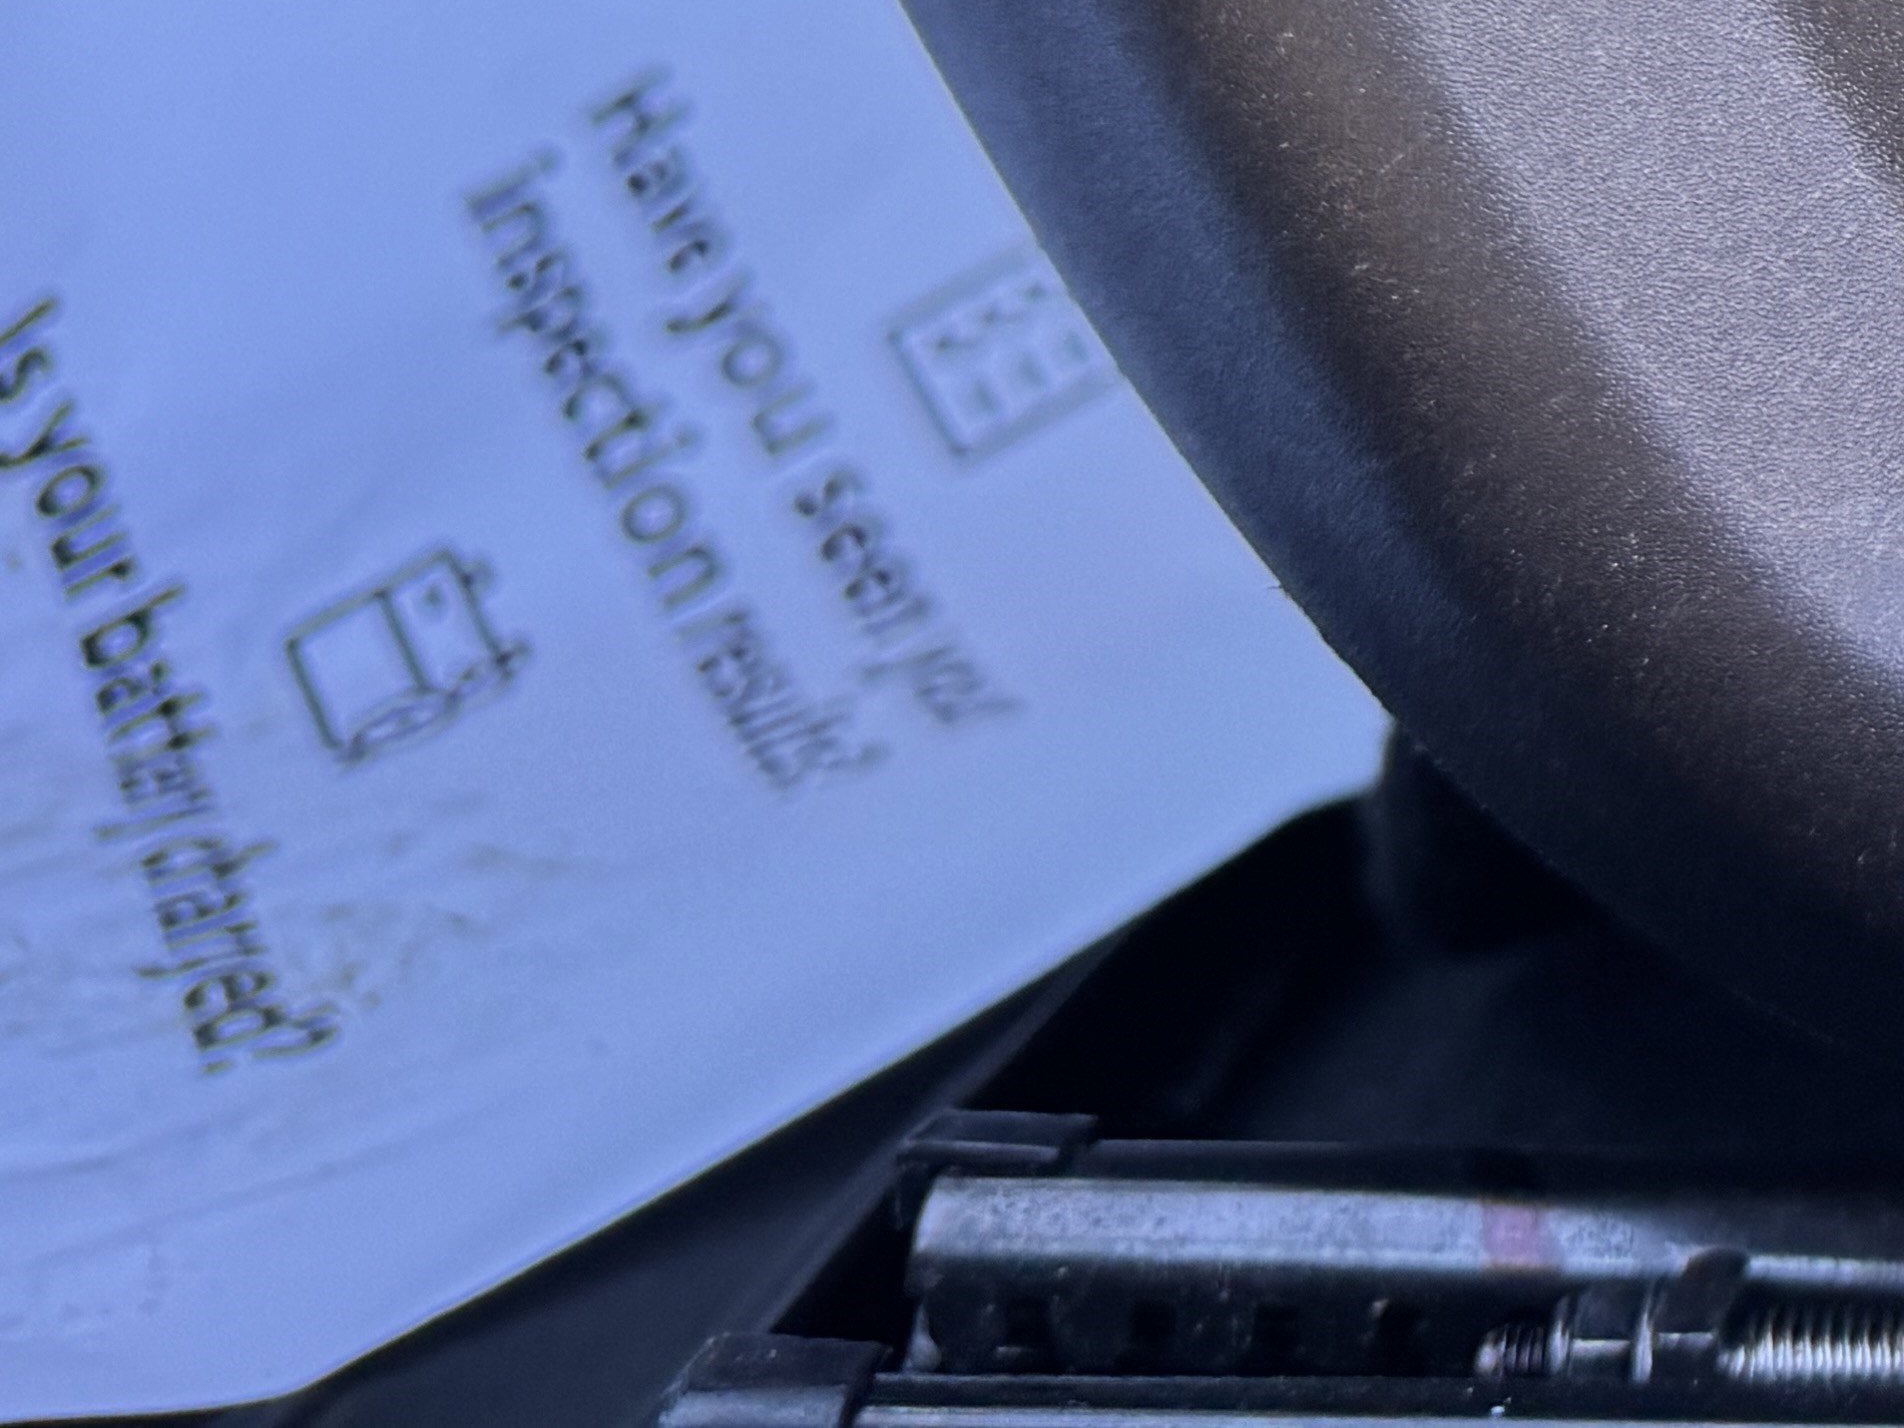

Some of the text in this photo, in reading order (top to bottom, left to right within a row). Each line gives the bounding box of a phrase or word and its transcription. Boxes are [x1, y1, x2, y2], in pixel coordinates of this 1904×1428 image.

[466, 148, 727, 612] inspection
[589, 66, 722, 278] Have
[664, 270, 835, 456] you
[791, 464, 935, 637] seen
[0, 296, 342, 1078] Is your battery charged?
